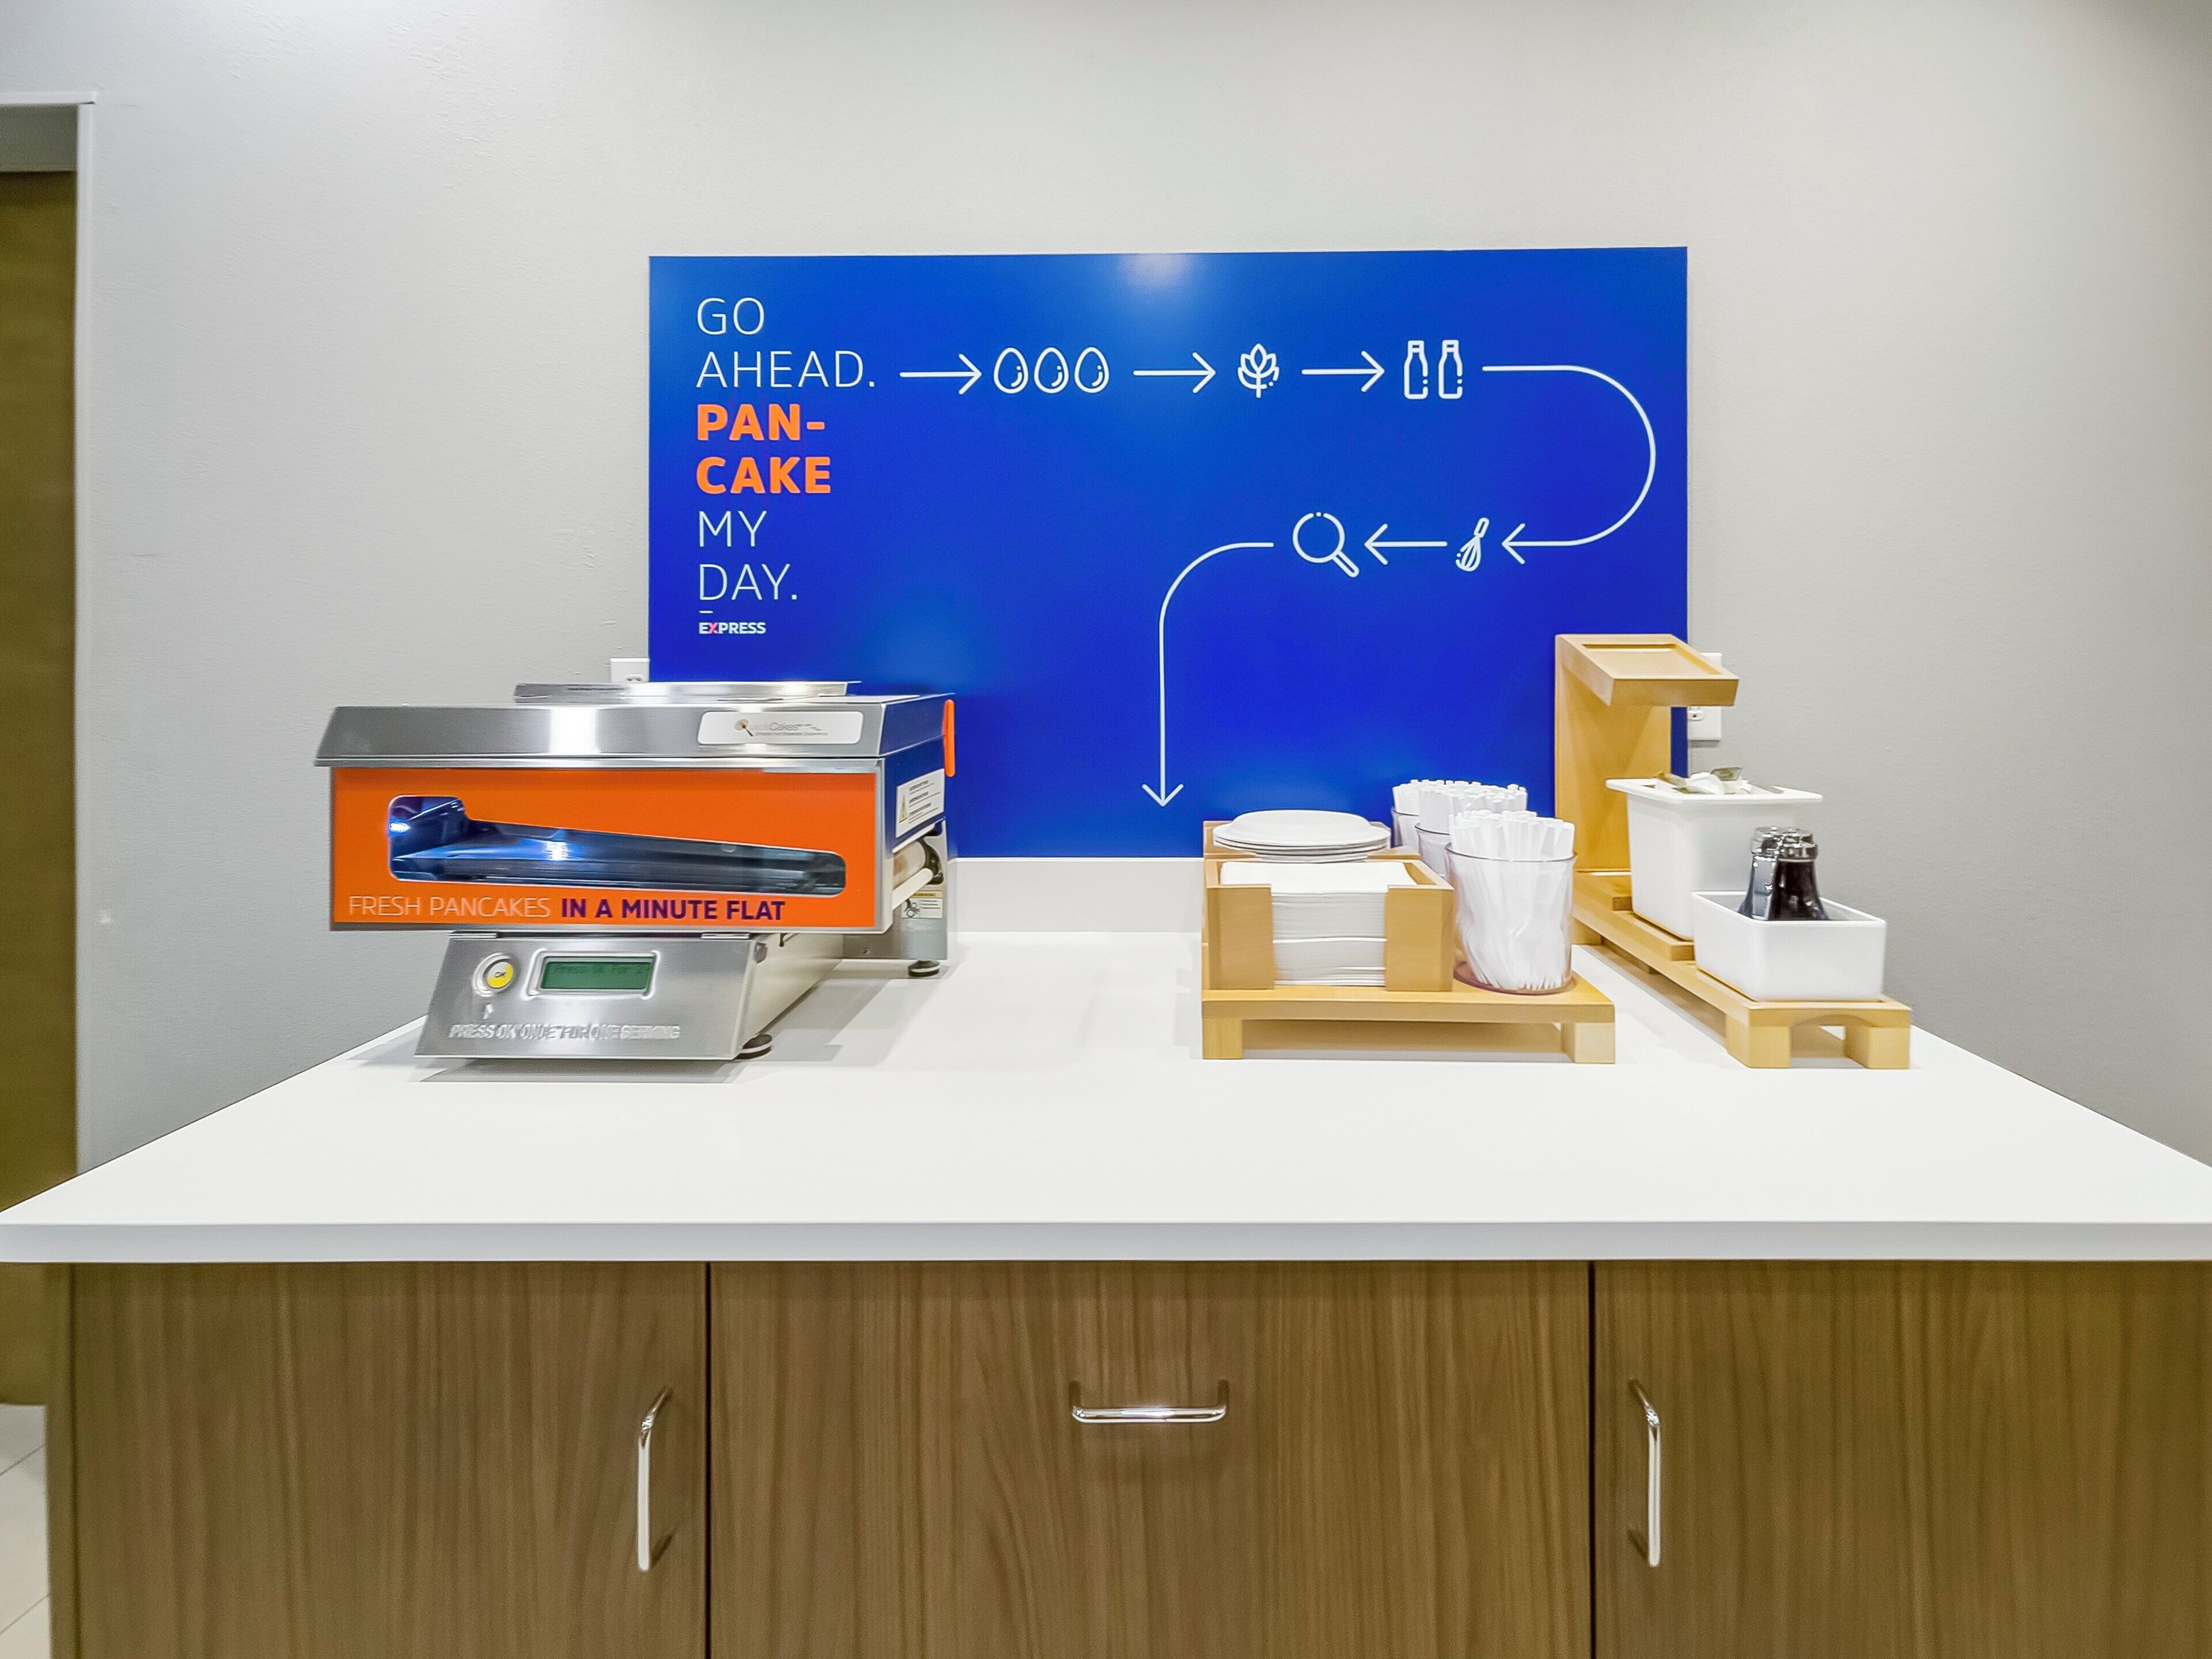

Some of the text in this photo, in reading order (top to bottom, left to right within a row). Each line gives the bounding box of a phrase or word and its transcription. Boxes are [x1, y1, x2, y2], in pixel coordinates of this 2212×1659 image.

[697, 297, 764, 335] GO
[696, 350, 874, 388] AHEAD.
[697, 403, 825, 441] PAN-
[696, 456, 831, 495] CAKE
[699, 510, 767, 547] MY
[699, 563, 797, 600] DAY.
[699, 622, 766, 634] EXPRESS
[349, 895, 786, 921] FRESH PANCAKES IN A MINUTE FLAT
[449, 1023, 496, 1039] PRESS
